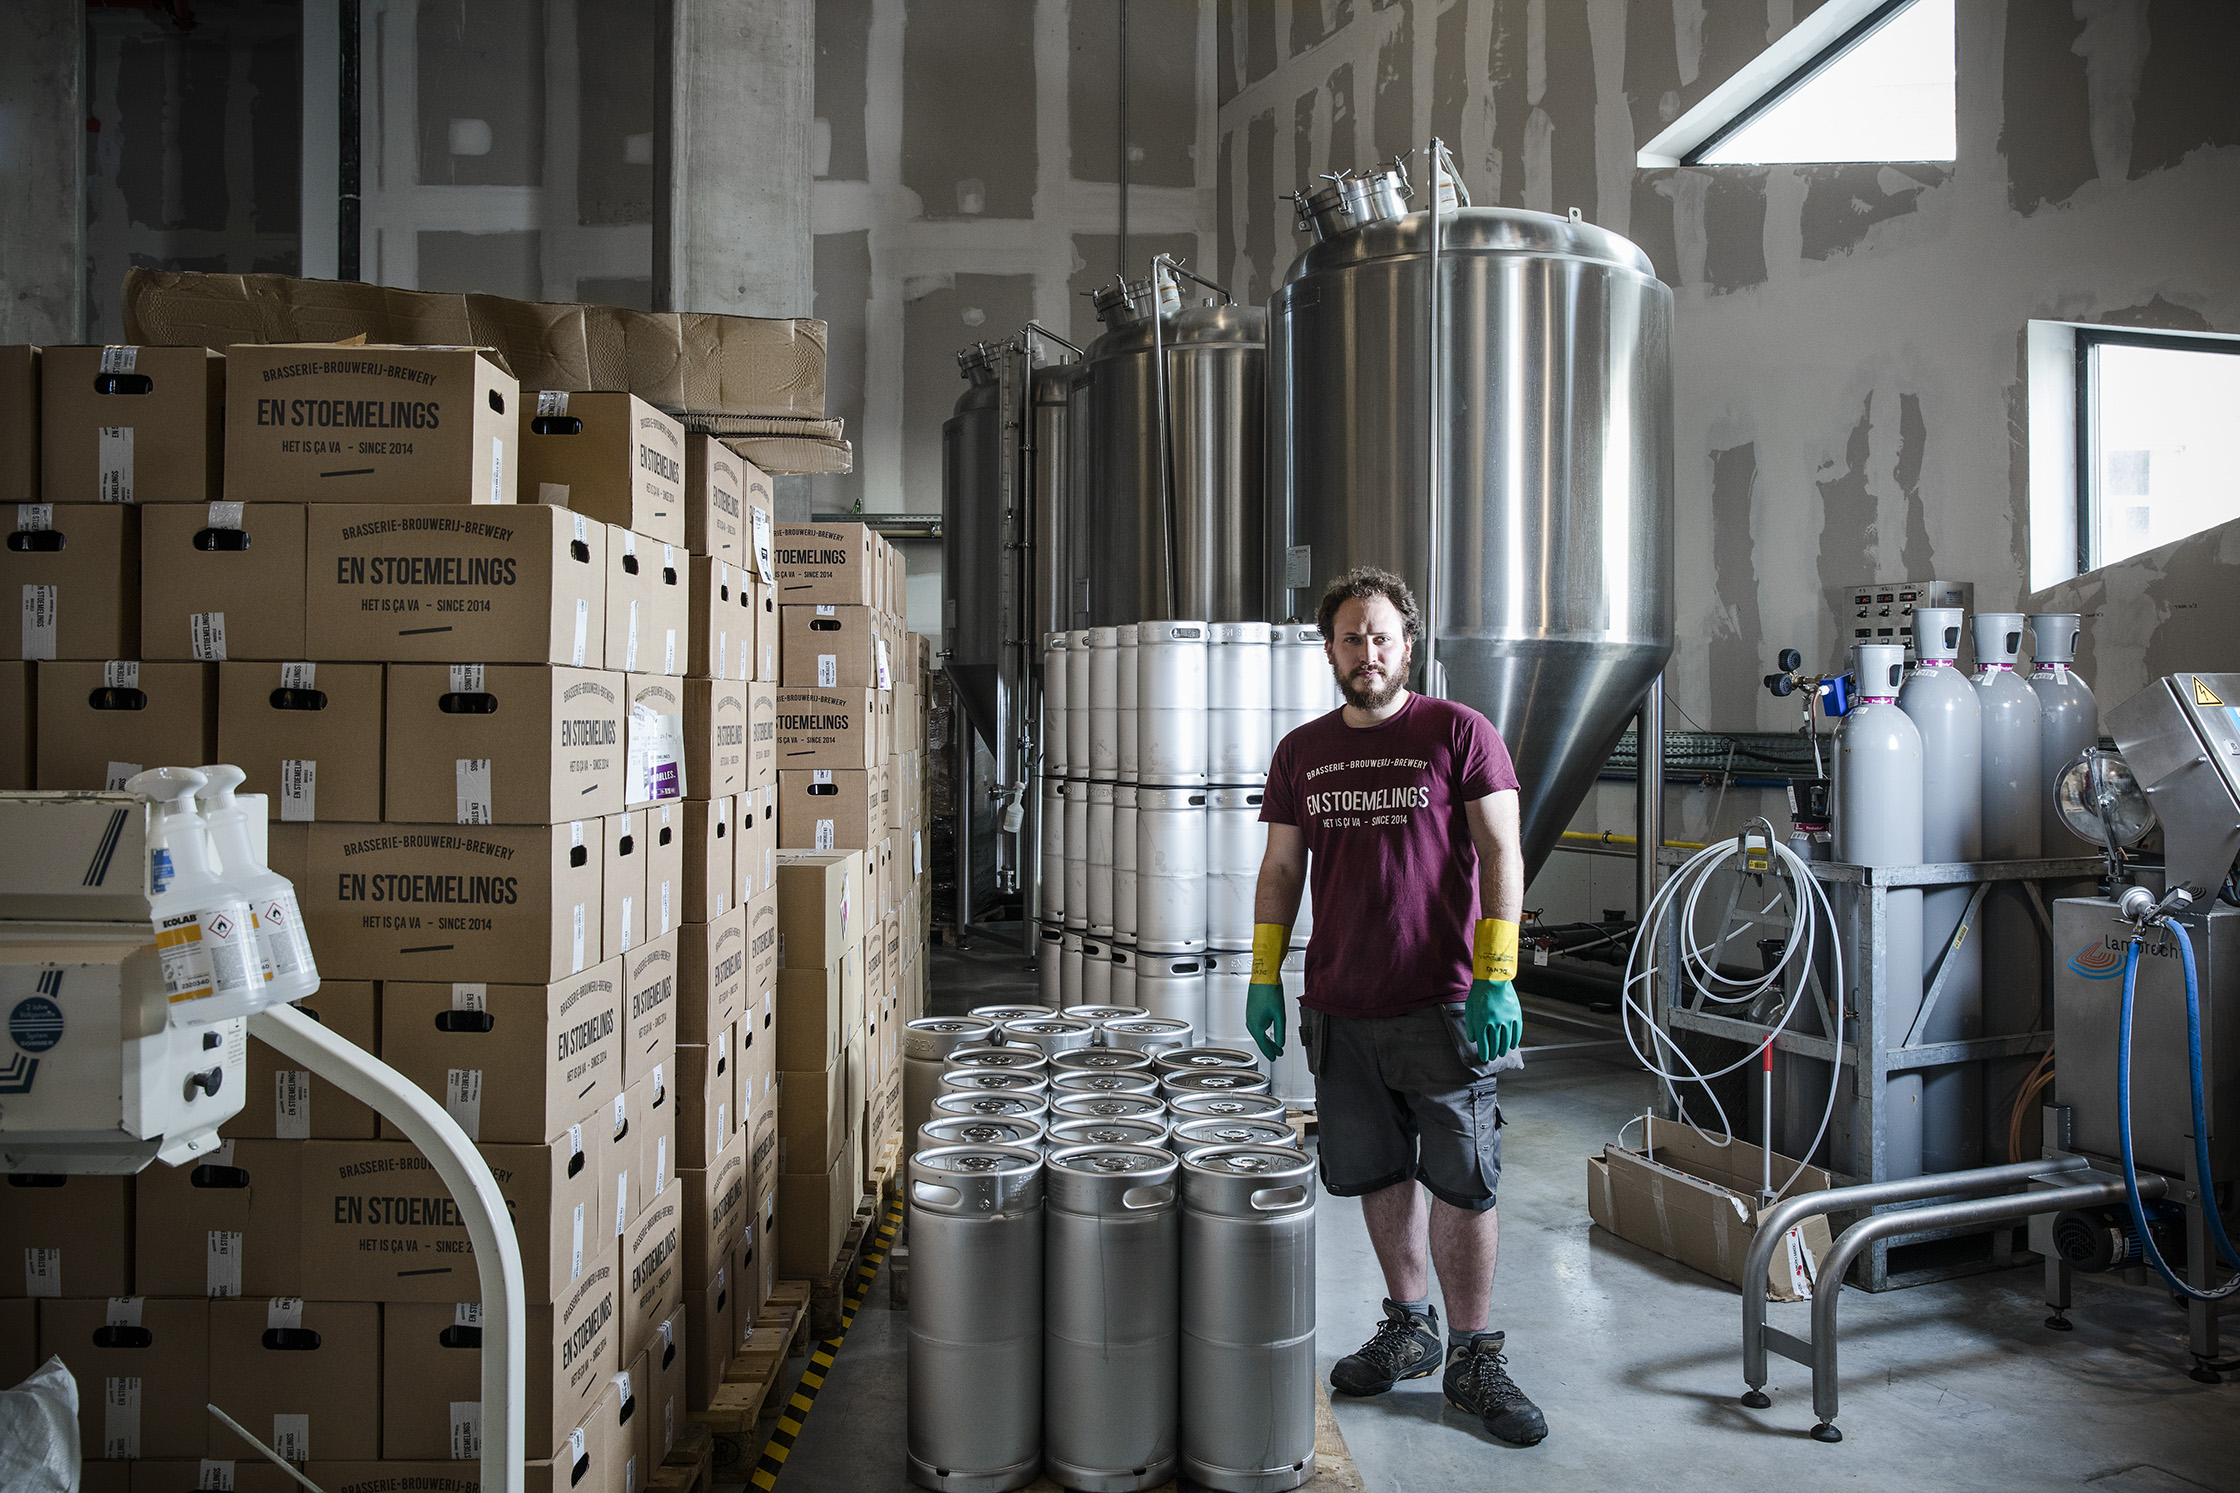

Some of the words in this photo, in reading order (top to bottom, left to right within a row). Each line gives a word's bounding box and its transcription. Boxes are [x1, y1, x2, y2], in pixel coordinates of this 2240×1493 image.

[263, 361, 437, 386] BRASSERIE-BROUWERIJ-BREWERY
[257, 399, 285, 426] EN
[291, 399, 440, 429] STOEMELINGS
[282, 441, 300, 453] HET
[303, 441, 312, 453] IS
[314, 441, 327, 455] ÇA
[329, 442, 341, 453] VA
[359, 442, 387, 454] SINCE
[389, 442, 413, 455] 2014
[342, 518, 514, 542] BRASSERIE-BROUWERIJ-BREWERY
[774, 528, 844, 541] RIE-BROUWERIJ-BREWERY
[337, 557, 364, 584] EN
[370, 557, 517, 586] STOEMELINGS
[361, 599, 379, 611] HET
[381, 599, 391, 611] IS
[393, 599, 405, 613] ÇA
[407, 599, 419, 611] VA
[437, 599, 464, 612] SINCE
[467, 600, 491, 612] 2014
[562, 720, 571, 747] EN
[573, 720, 616, 746] STOEMELINGS
[1306, 758, 1428, 780] BRASSERIE-BROUWERIJ-BREWERY
[1306, 793, 1321, 816] EN
[1322, 786, 1429, 812] STOEMELINGS
[1391, 815, 1407, 824] 2014
[344, 835, 515, 861] BRASSERIE-BROUWERIJ-BREWERY
[339, 874, 366, 901] EN
[372, 874, 518, 904] STOEMELINGS
[163, 914, 198, 928] ECOLAB
[362, 916, 380, 928] HET
[383, 916, 392, 928] IS
[394, 917, 407, 930] ÇA
[409, 917, 421, 928] VA
[438, 917, 466, 930] SINCE
[468, 918, 492, 930] 2014
[559, 1031, 568, 1061] EN
[570, 1008, 613, 1055] STOEMELINGS
[335, 1196, 362, 1223] EN
[359, 1239, 377, 1251] HET
[379, 1240, 389, 1251] IS
[391, 1240, 402, 1253] ÇA
[406, 1240, 418, 1251] VA
[436, 1241, 464, 1253] SINCE
